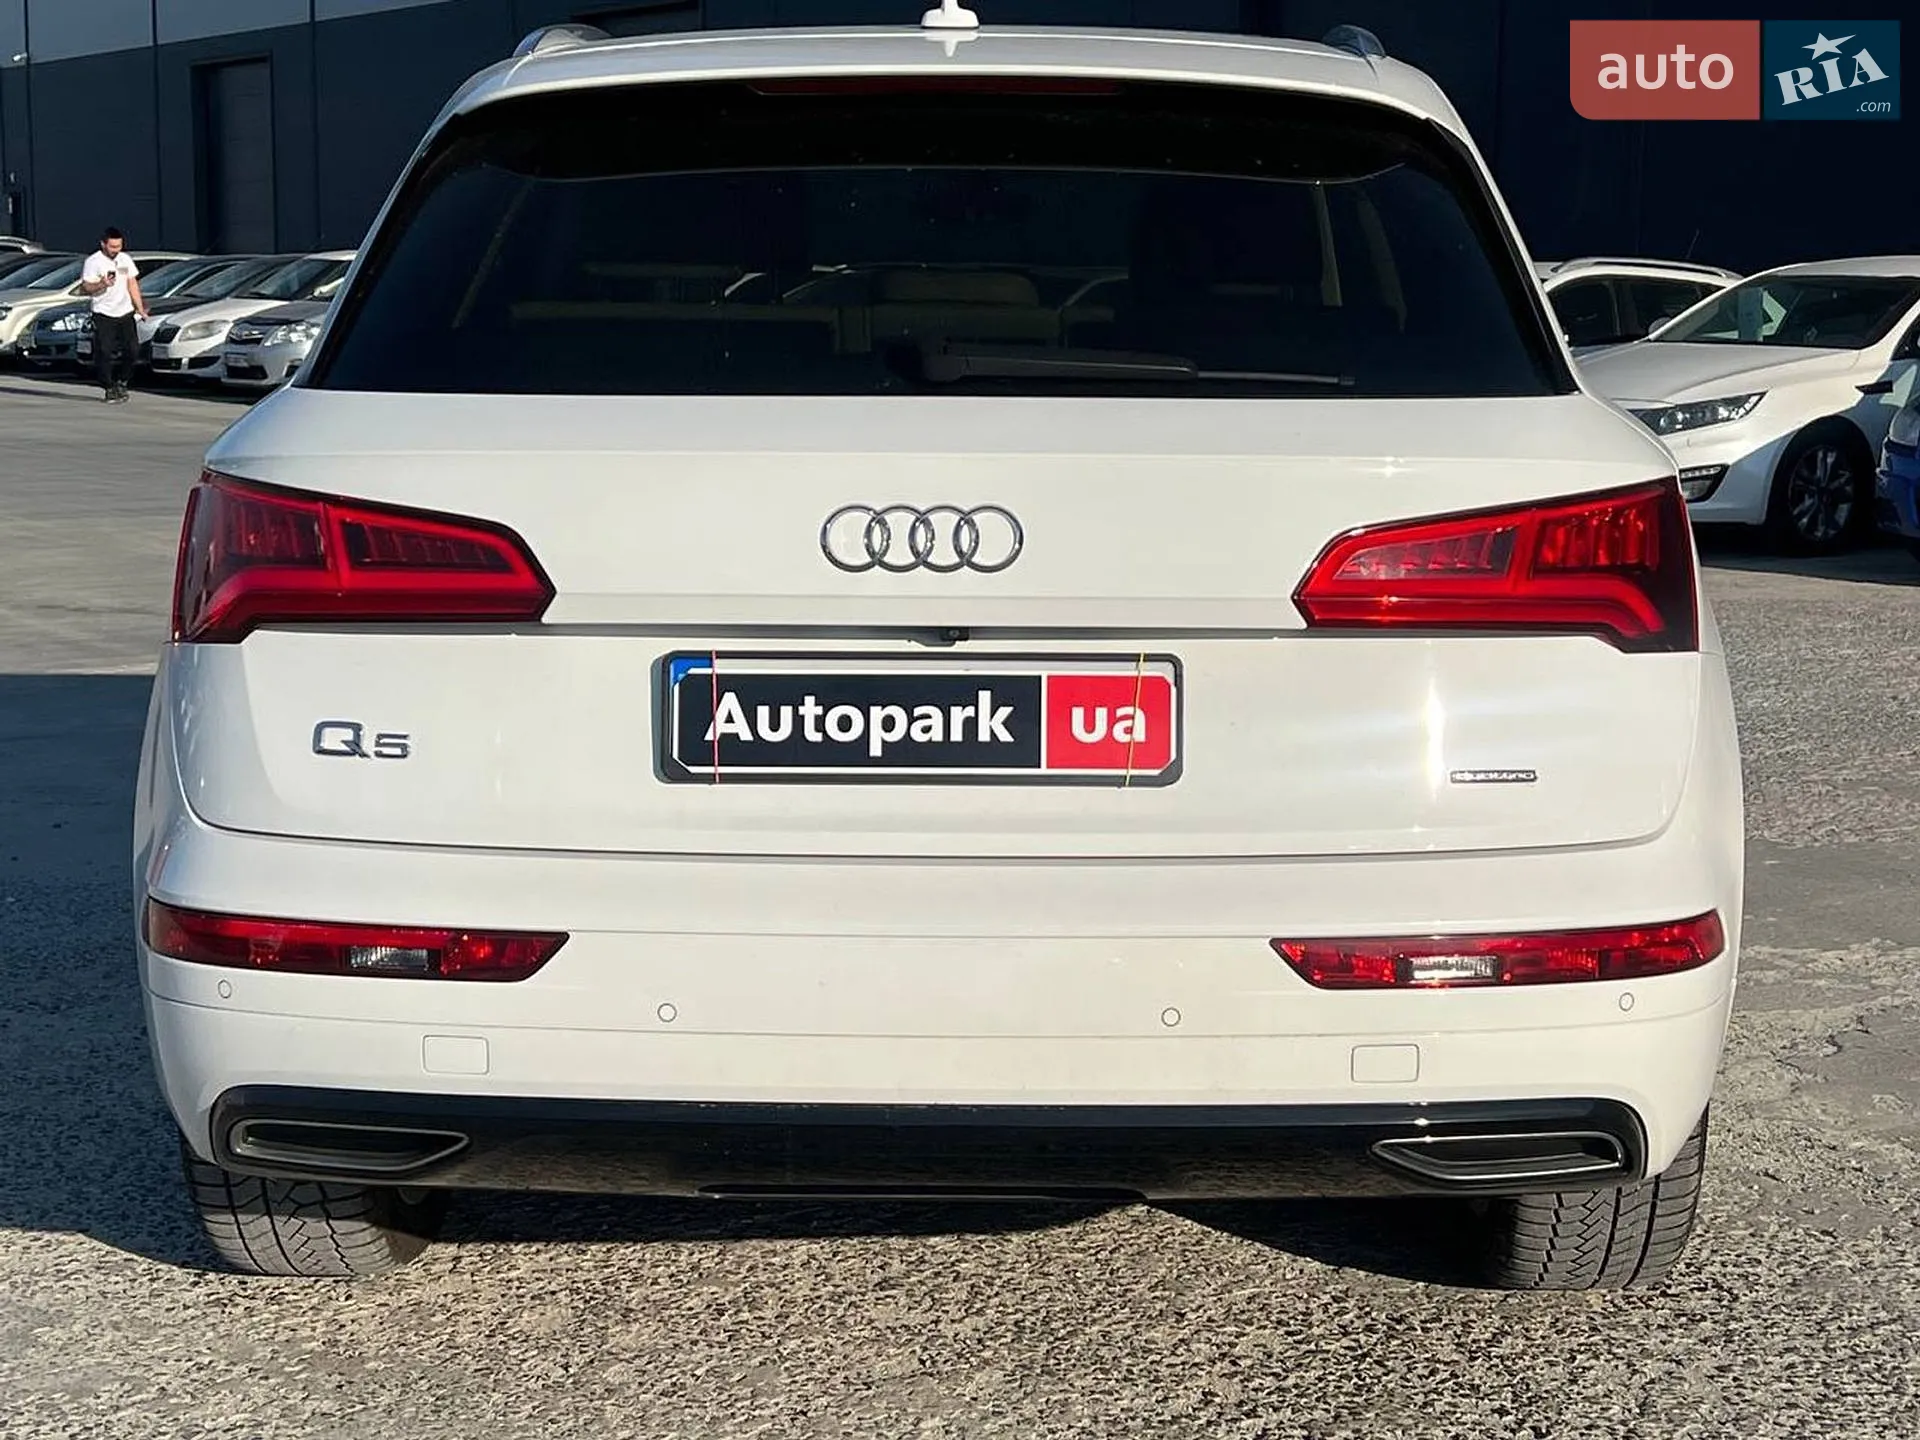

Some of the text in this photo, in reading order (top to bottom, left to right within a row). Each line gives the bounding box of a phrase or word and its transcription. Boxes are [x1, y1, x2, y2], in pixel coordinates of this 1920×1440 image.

[312, 720, 409, 759] Q5
[703, 690, 1147, 757] Autopark ua
